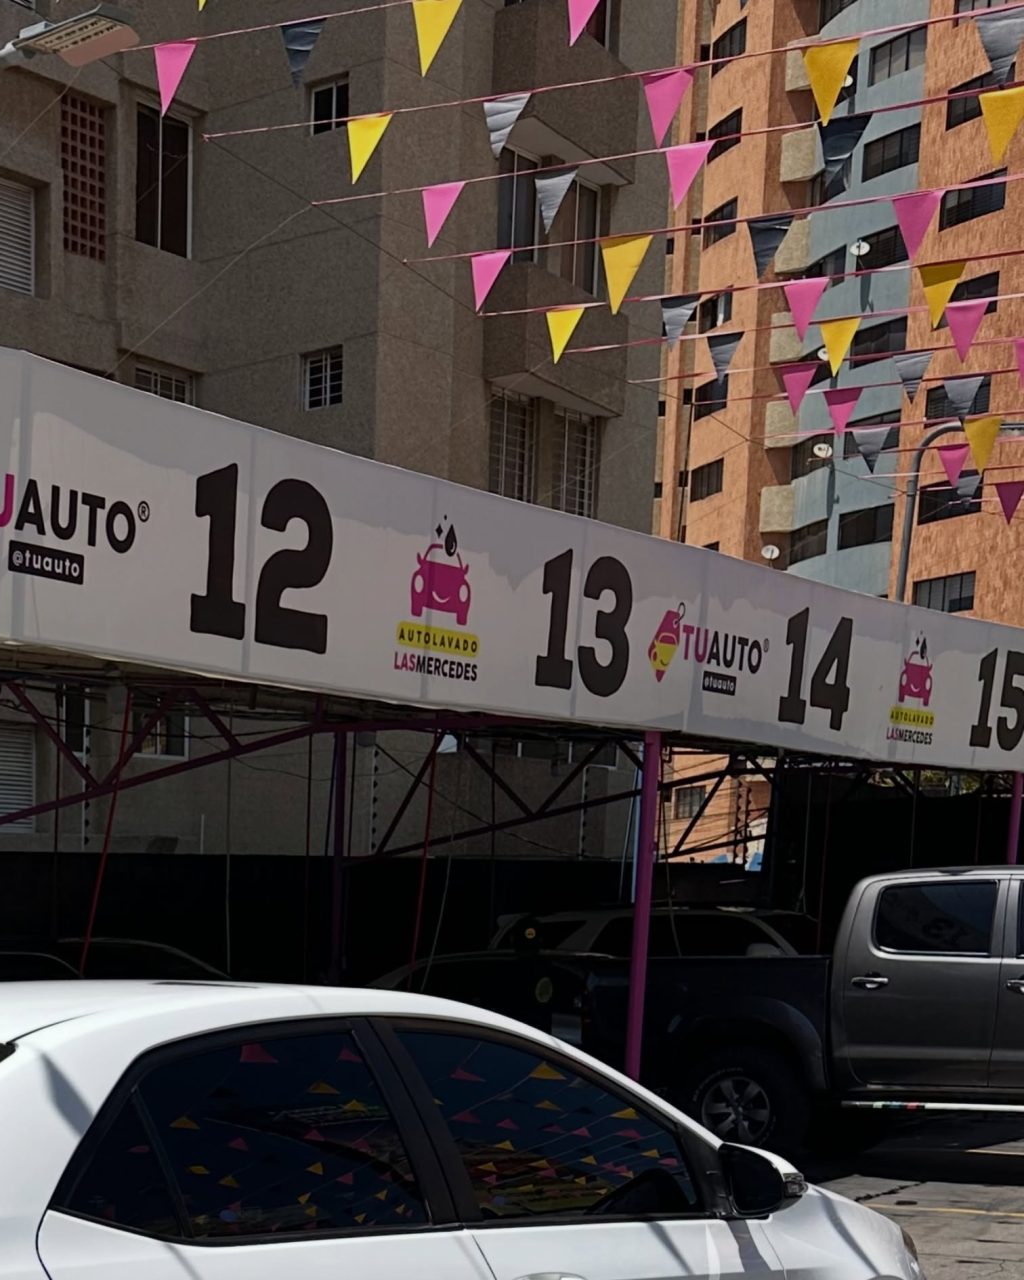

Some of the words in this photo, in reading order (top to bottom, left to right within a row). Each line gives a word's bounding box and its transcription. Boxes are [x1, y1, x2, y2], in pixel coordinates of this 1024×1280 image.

[11, 548, 81, 578] @tuauto
[190, 463, 333, 654] 12
[535, 548, 633, 697] 13
[399, 628, 478, 653] AUTOLAVADO
[394, 652, 478, 682] LASMERCEDES
[778, 607, 853, 731] 14
[969, 648, 1024, 751] 15
[890, 710, 934, 725] AUTOLAVADO
[886, 727, 933, 745] LASMERCEDES
